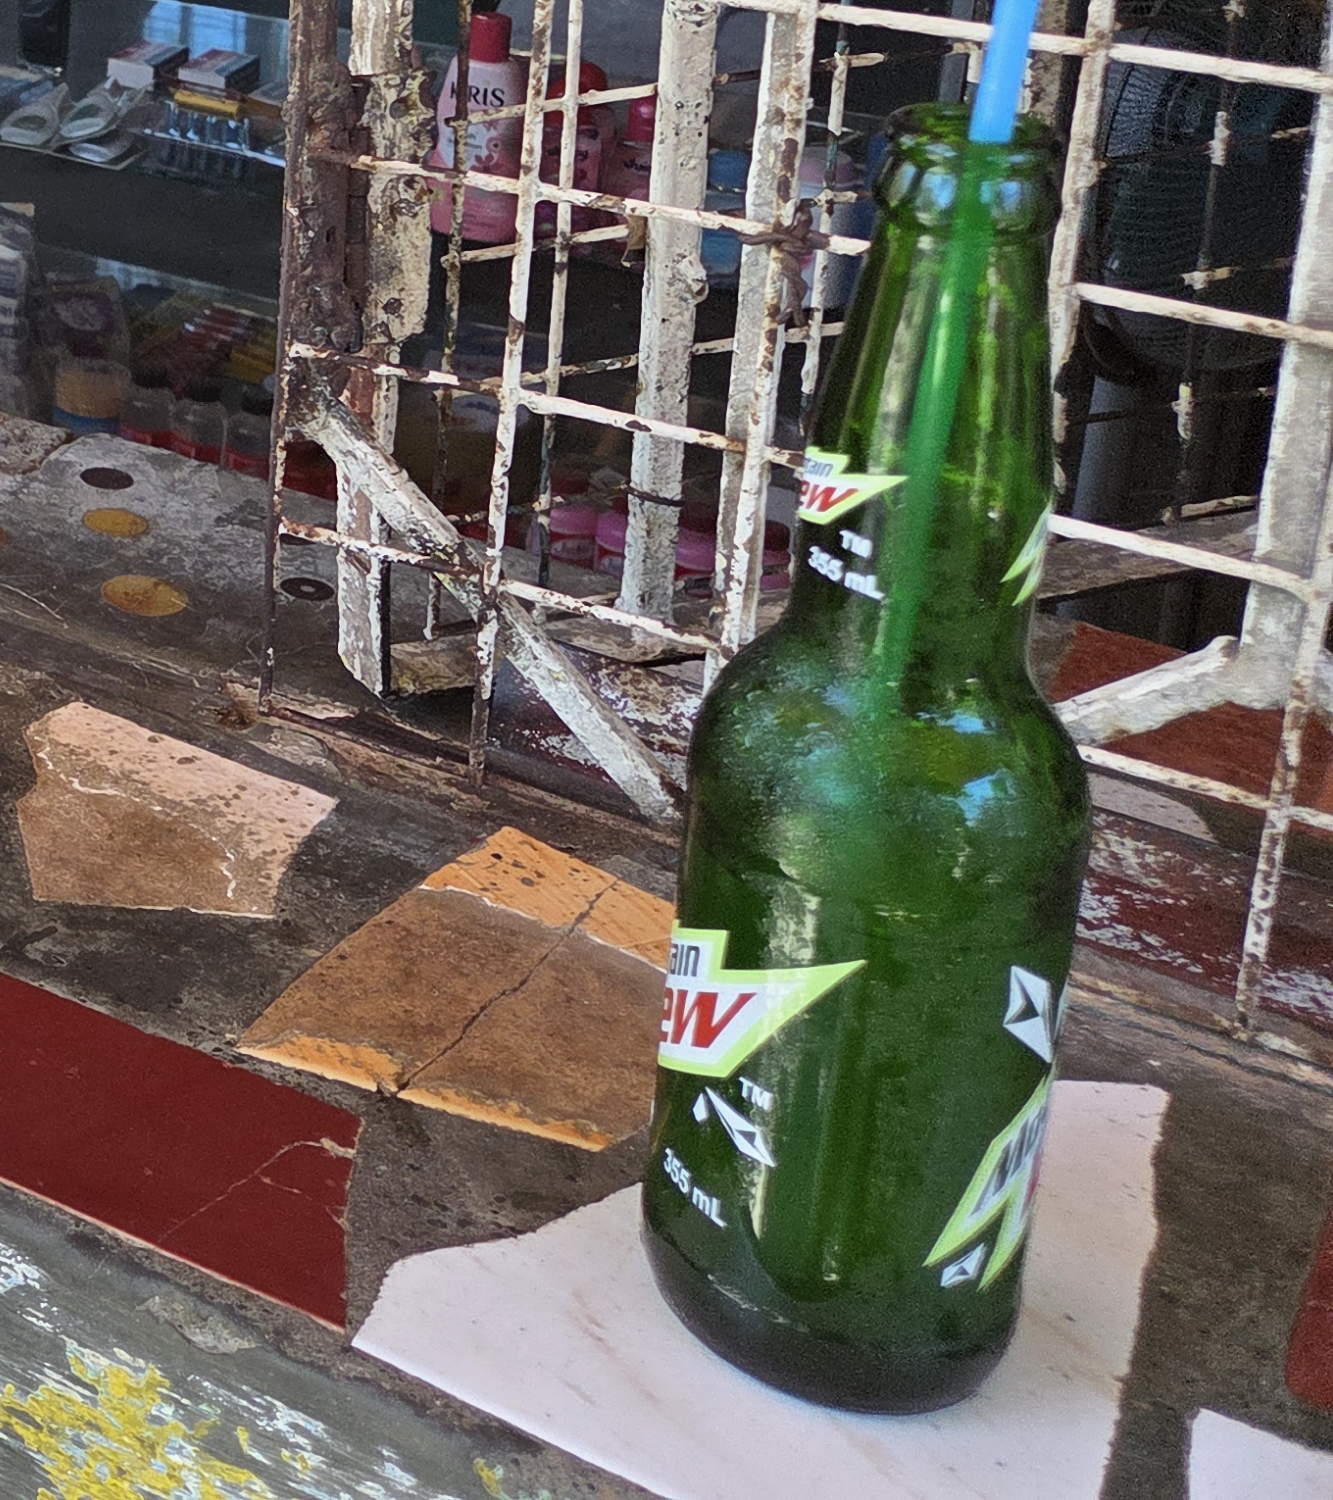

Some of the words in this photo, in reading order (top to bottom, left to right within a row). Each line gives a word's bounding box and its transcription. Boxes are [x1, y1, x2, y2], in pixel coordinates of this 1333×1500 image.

[839, 529, 873, 560] TM
[808, 545, 844, 582] 355
[844, 571, 885, 601] mL
[738, 1076, 774, 1112] TM
[663, 1147, 692, 1196] 355
[692, 1185, 728, 1229] mL
